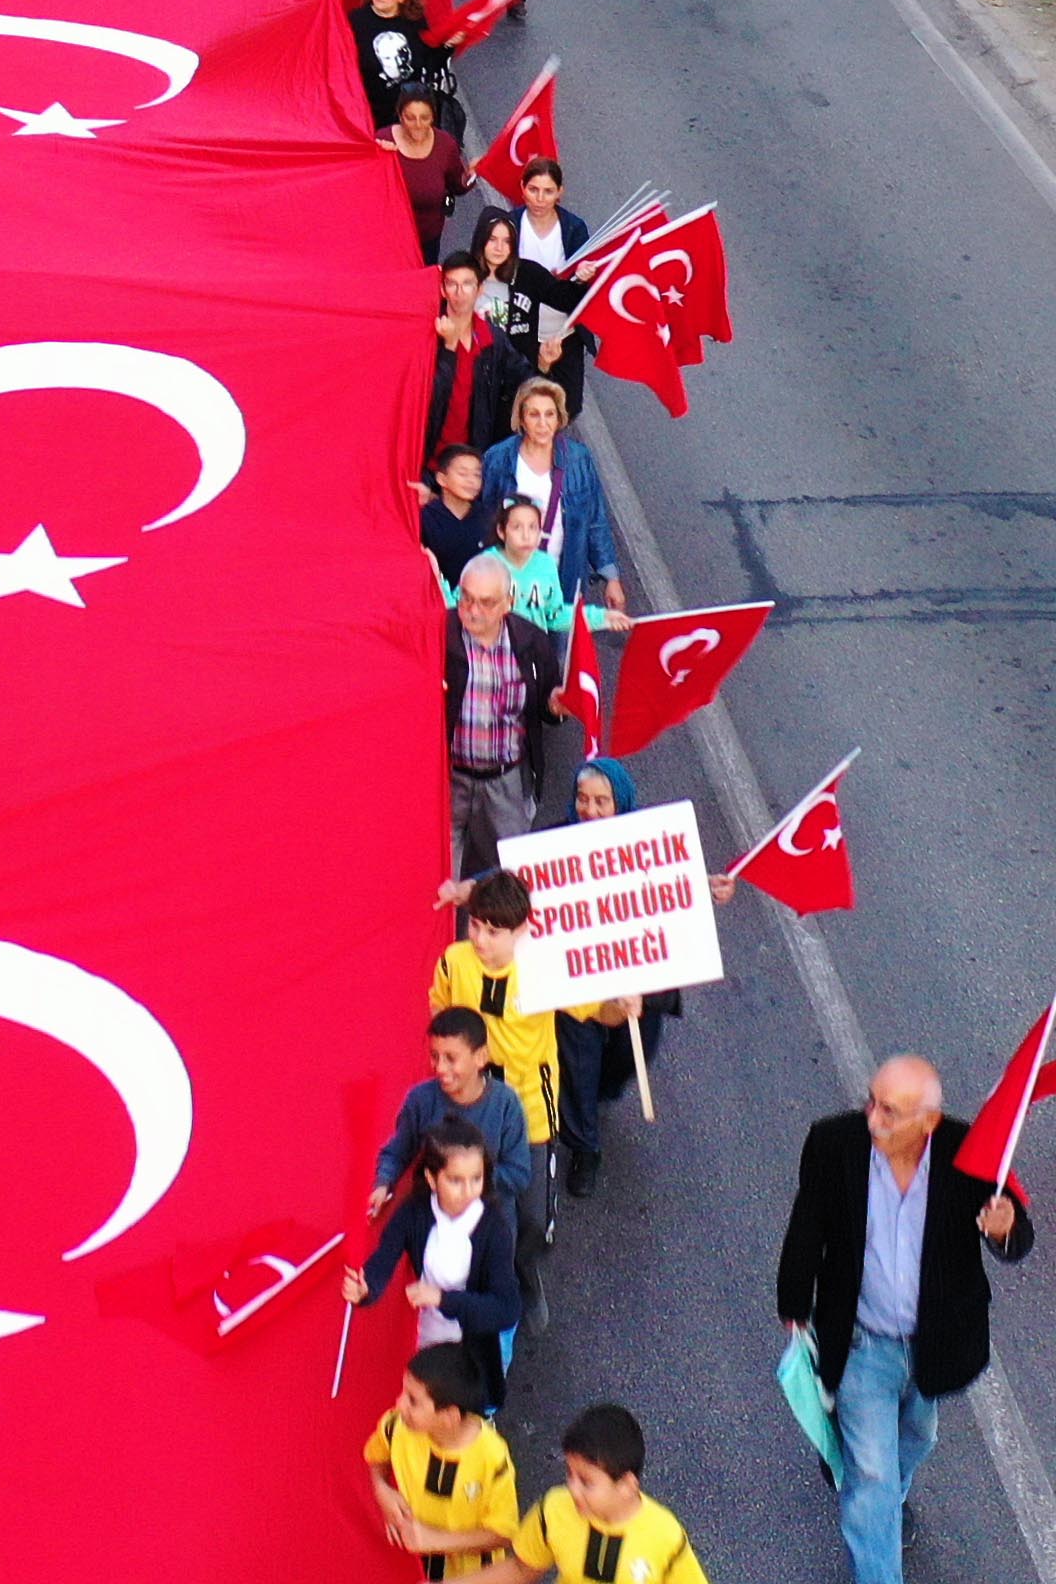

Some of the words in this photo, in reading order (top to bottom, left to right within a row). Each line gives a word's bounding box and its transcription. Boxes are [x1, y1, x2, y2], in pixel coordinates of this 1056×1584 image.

[521, 855, 584, 893] ONUR
[589, 830, 690, 880] GENÇLİK
[528, 901, 592, 940] SPOR
[598, 874, 694, 925] KULÜBÜ
[565, 926, 670, 979] DERNEĞİ
